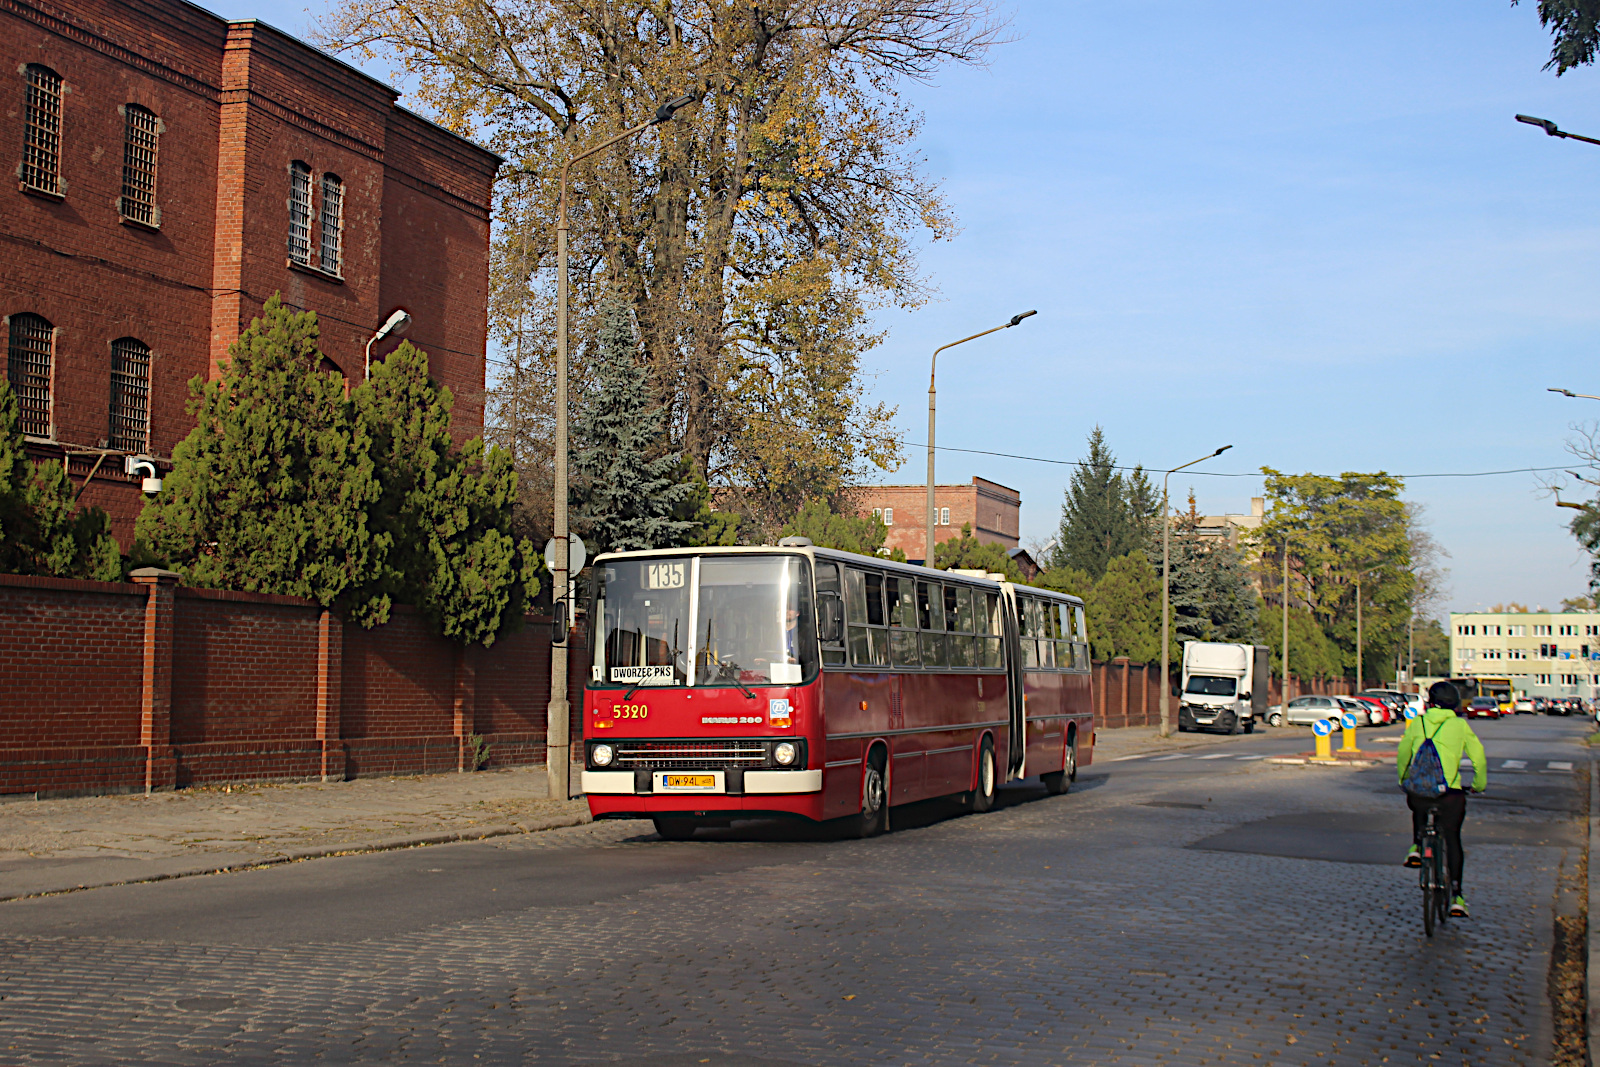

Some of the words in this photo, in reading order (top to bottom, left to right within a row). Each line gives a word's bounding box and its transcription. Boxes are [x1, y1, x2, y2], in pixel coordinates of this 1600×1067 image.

[652, 563, 681, 587] 135
[614, 667, 652, 678] DWORZEC
[654, 666, 671, 677] PKS
[613, 704, 648, 719] 5320
